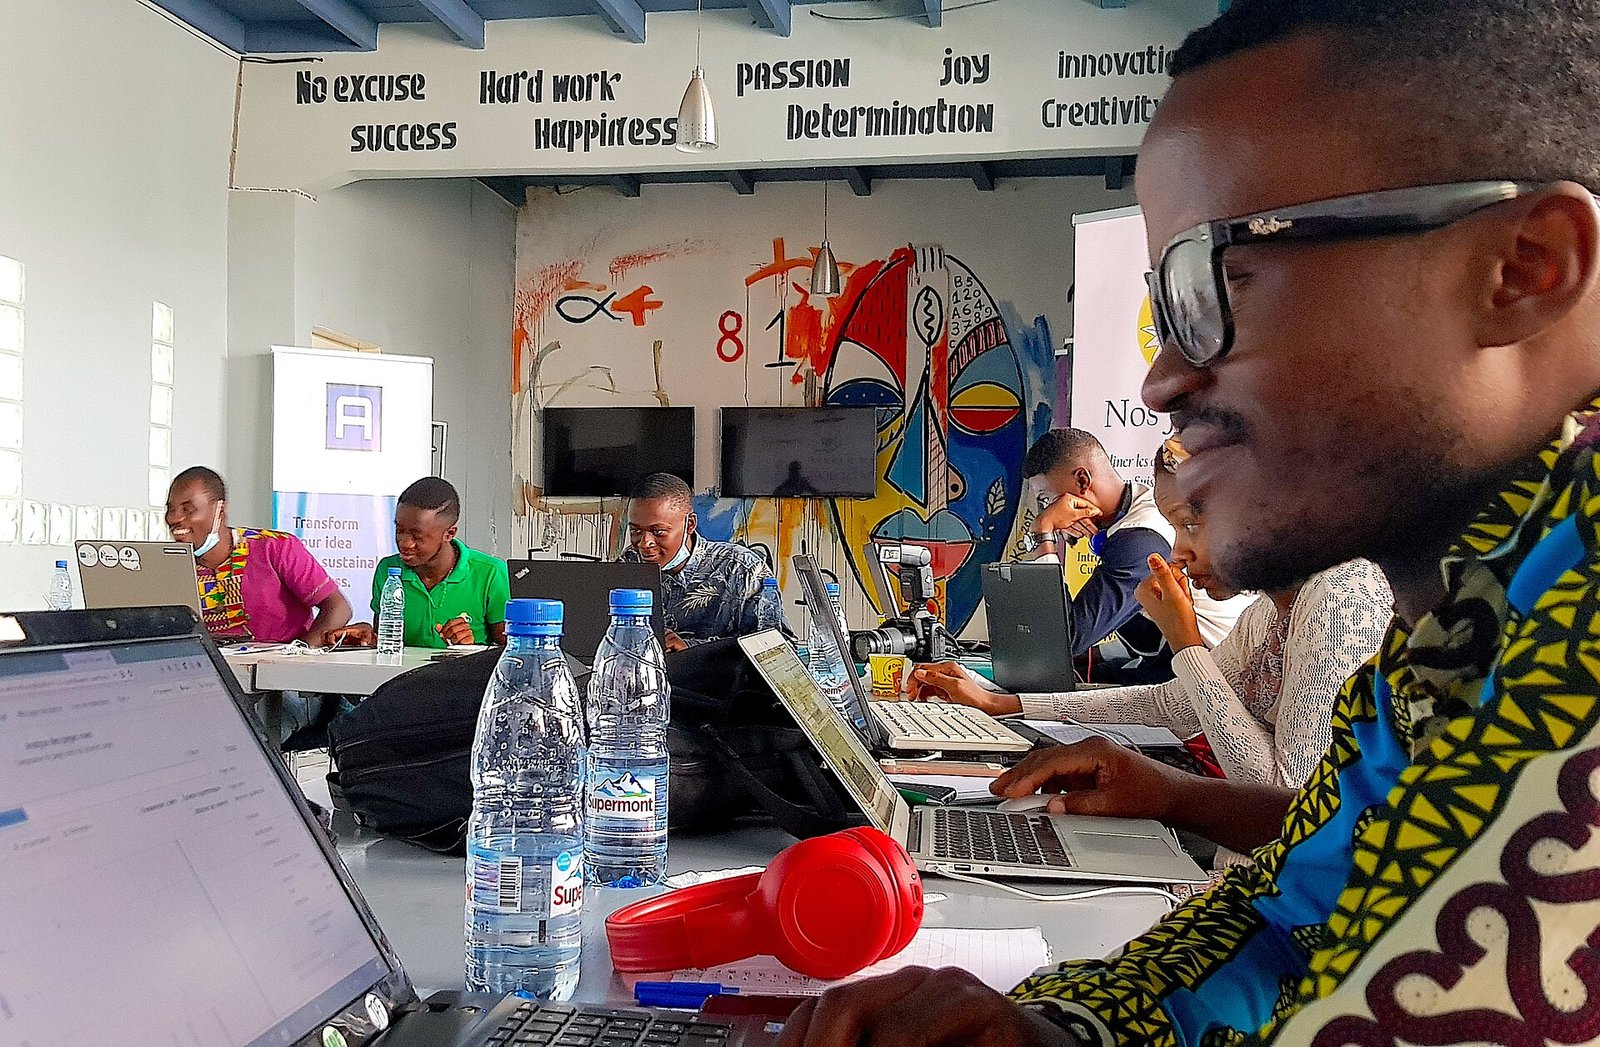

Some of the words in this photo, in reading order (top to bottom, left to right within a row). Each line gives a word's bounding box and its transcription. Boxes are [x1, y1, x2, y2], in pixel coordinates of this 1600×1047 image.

[940, 47, 990, 86] joy
[296, 71, 327, 104] No
[334, 74, 425, 102] excuse
[480, 70, 543, 104] Hard
[552, 70, 622, 102] work
[534, 113, 678, 152] Happiness
[716, 310, 744, 363] 8
[765, 309, 797, 368] 1
[1104, 398, 1158, 428] Nos
[292, 516, 359, 530] Transform
[325, 535, 352, 549] idea
[588, 793, 653, 813] Supermont
